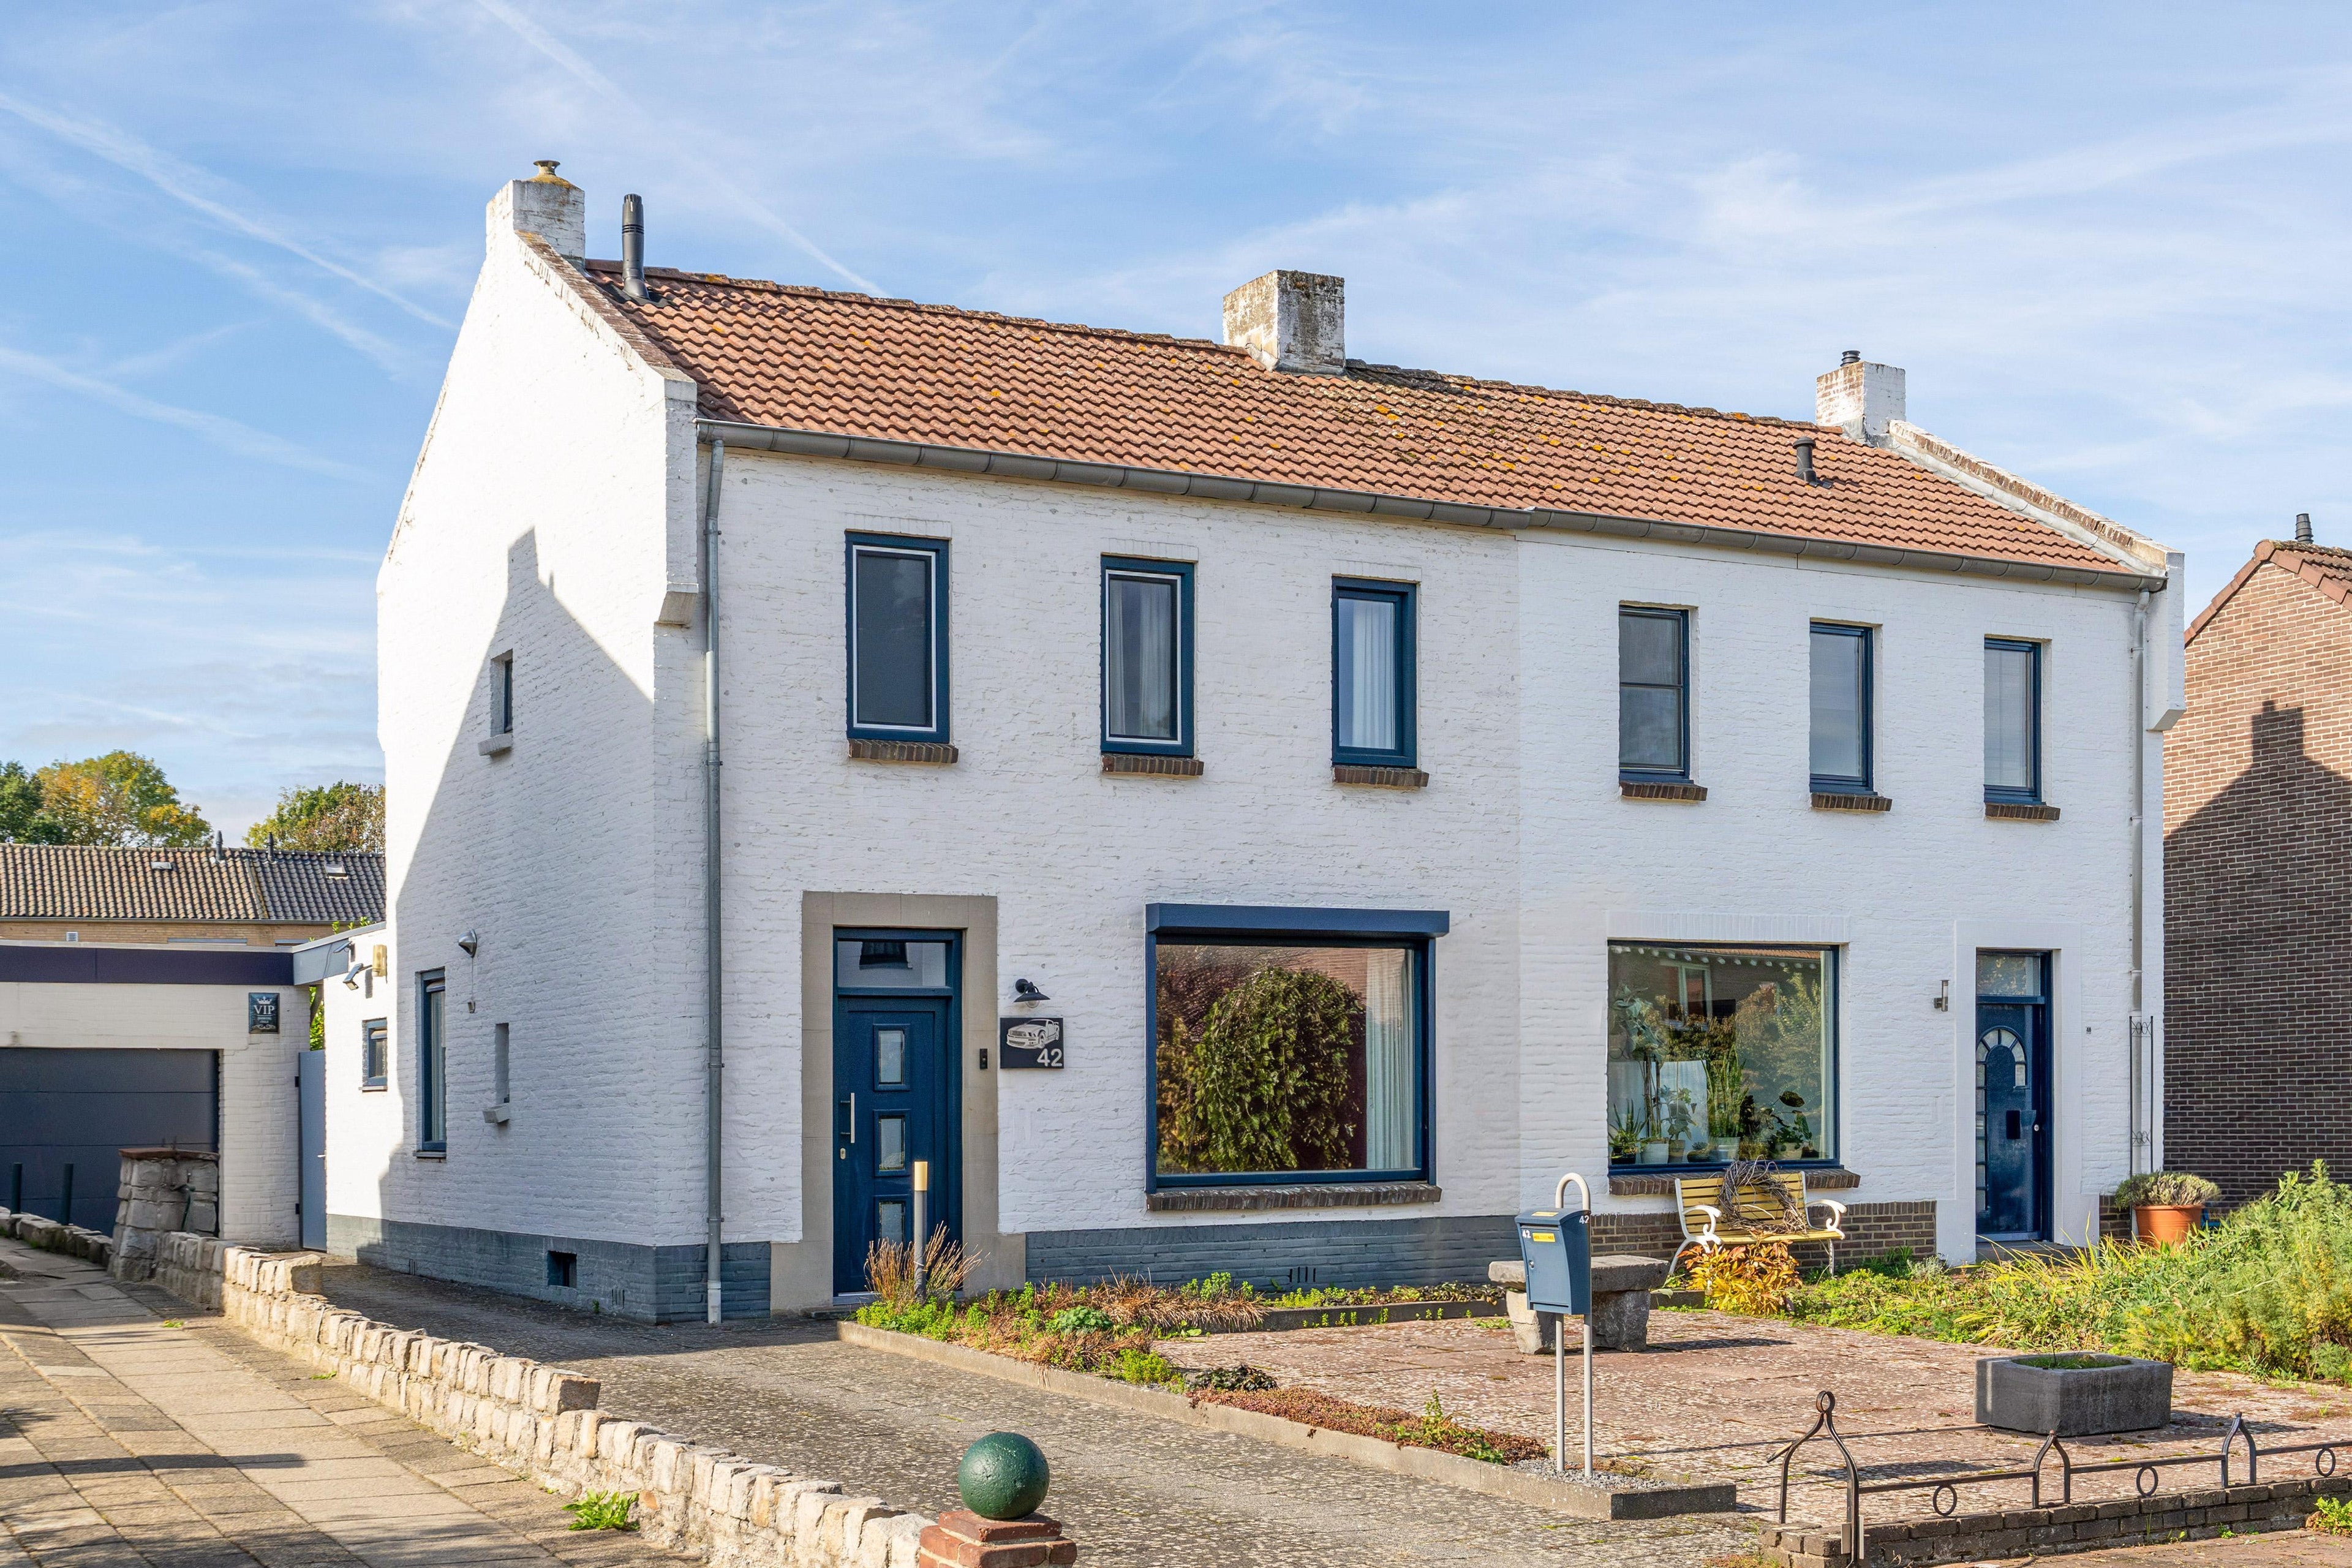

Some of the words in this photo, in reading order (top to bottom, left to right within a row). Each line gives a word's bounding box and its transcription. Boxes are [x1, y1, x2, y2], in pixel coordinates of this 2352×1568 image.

[254, 1005, 274, 1014] VIP
[1037, 1049, 1063, 1066] 42
[1579, 1215, 1589, 1224] 42
[1522, 1229, 1531, 1238] 42
